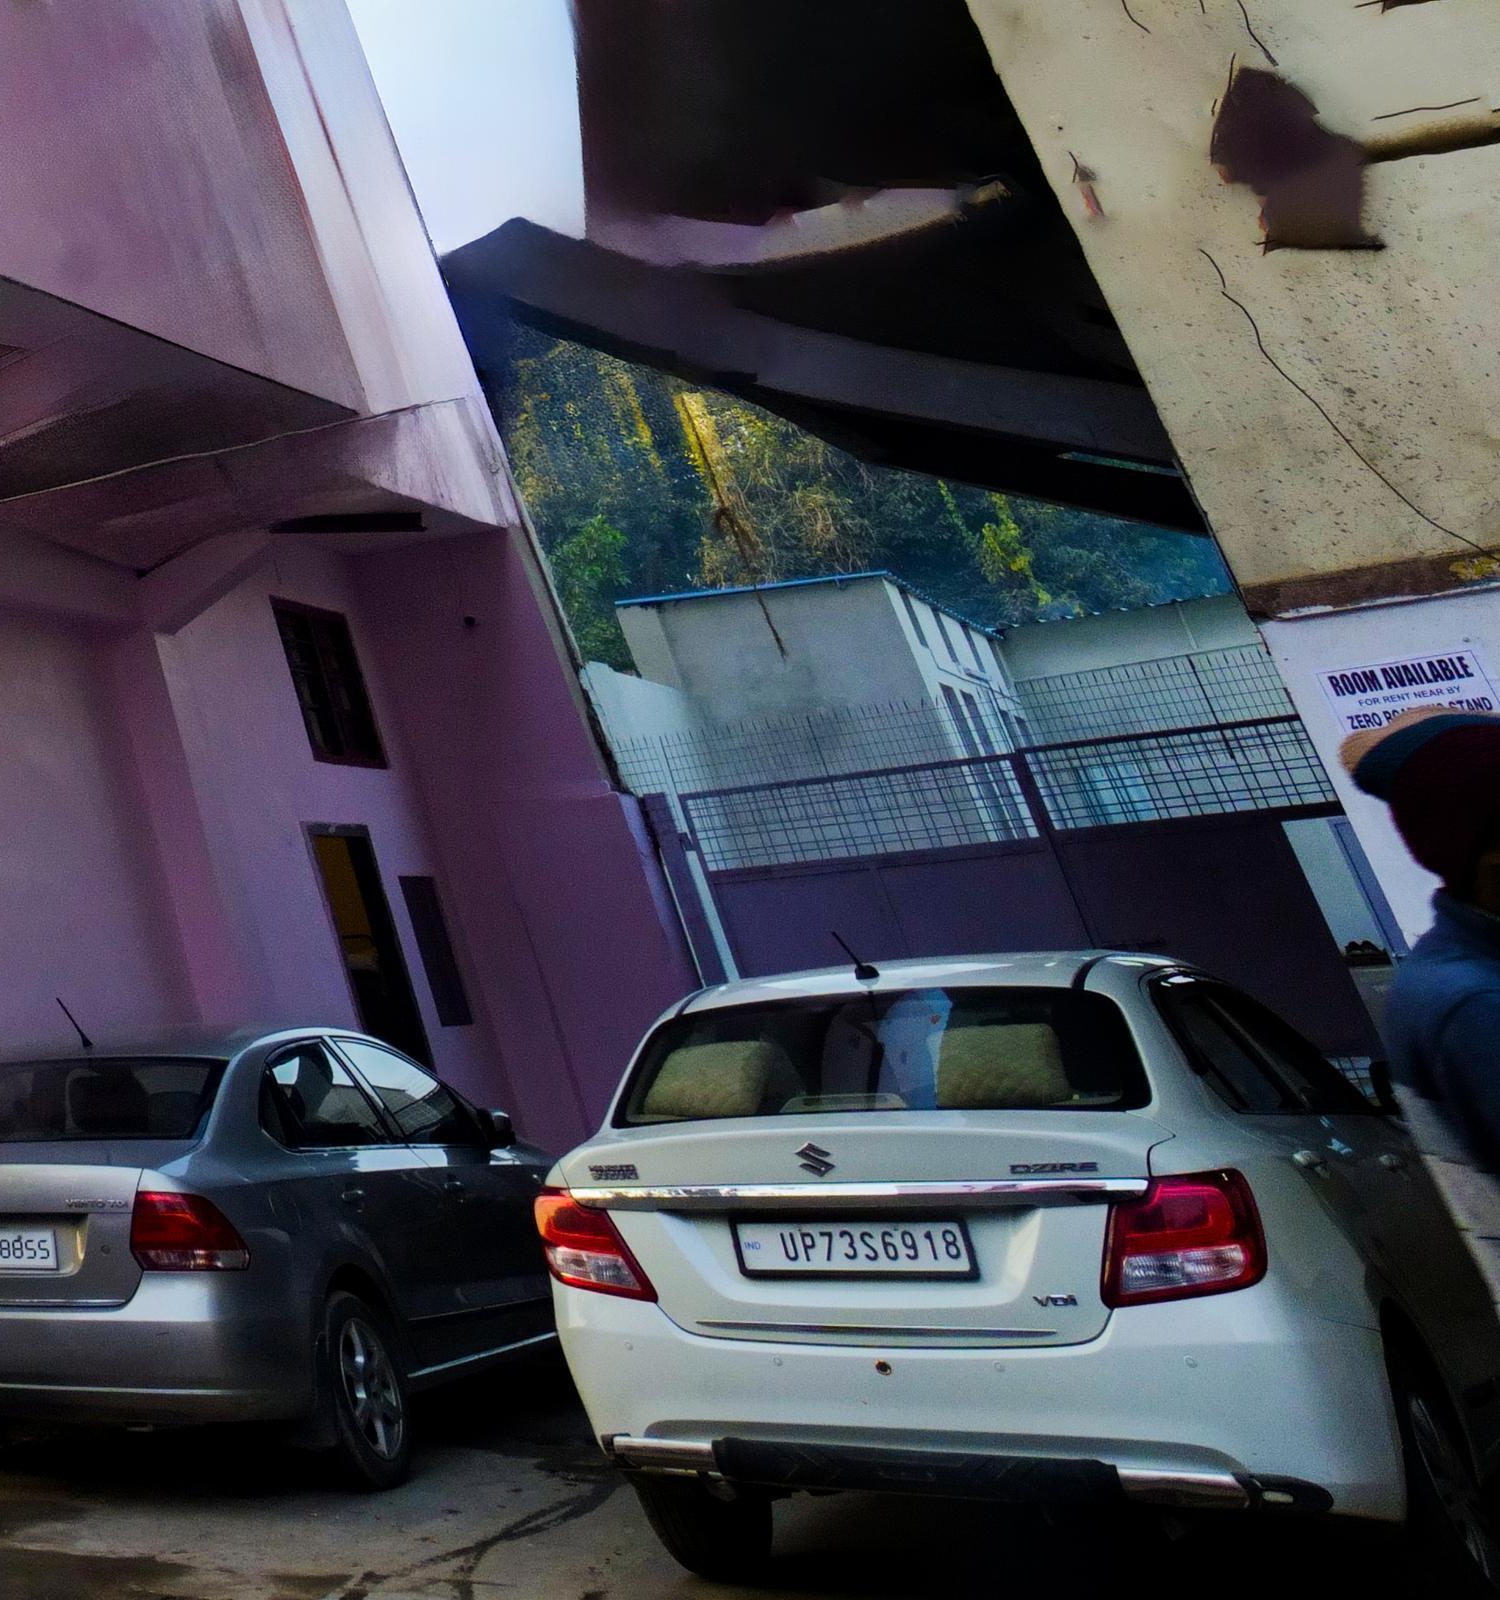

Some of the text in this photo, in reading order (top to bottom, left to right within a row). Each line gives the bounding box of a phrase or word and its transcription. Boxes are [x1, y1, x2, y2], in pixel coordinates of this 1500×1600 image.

[1327, 655, 1474, 697] ROOM AVAILABLE
[1358, 697, 1381, 707] FOR
[1382, 692, 1411, 705] RENT
[1413, 688, 1445, 701] NEAR
[1446, 685, 1462, 695] BY
[1346, 712, 1383, 730] ZERO
[1010, 1161, 1098, 1174] DZIRE
[743, 1229, 962, 1262] IND UP73S6918
